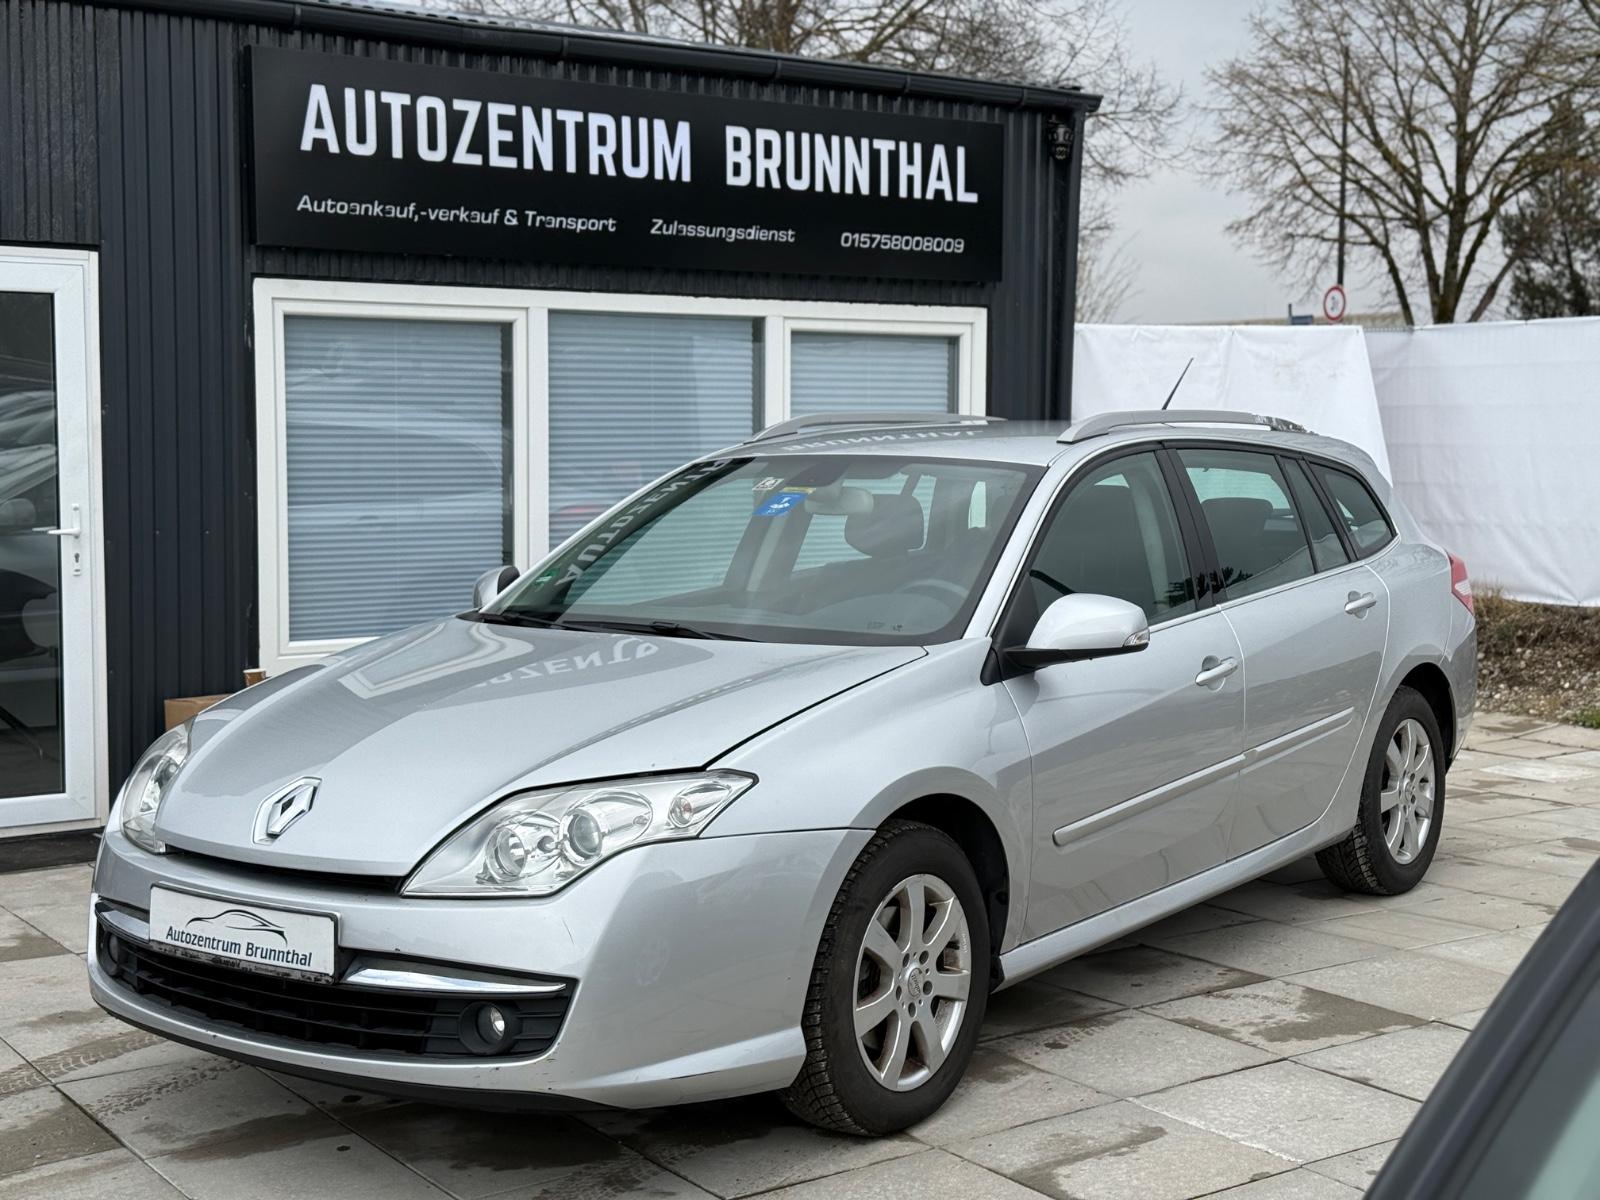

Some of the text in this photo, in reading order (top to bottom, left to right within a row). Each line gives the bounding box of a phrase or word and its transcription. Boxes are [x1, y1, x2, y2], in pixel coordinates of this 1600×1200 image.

[300, 83, 979, 203] AUTOZENTRUM BRUNNTHAL
[296, 194, 617, 233] Autoankauf,-verkauf & Transport
[650, 218, 796, 243] Zulassungsdienst
[840, 231, 965, 254] 015758008009
[165, 926, 241, 955] Autozentrum
[245, 942, 312, 967] Brunnthal
